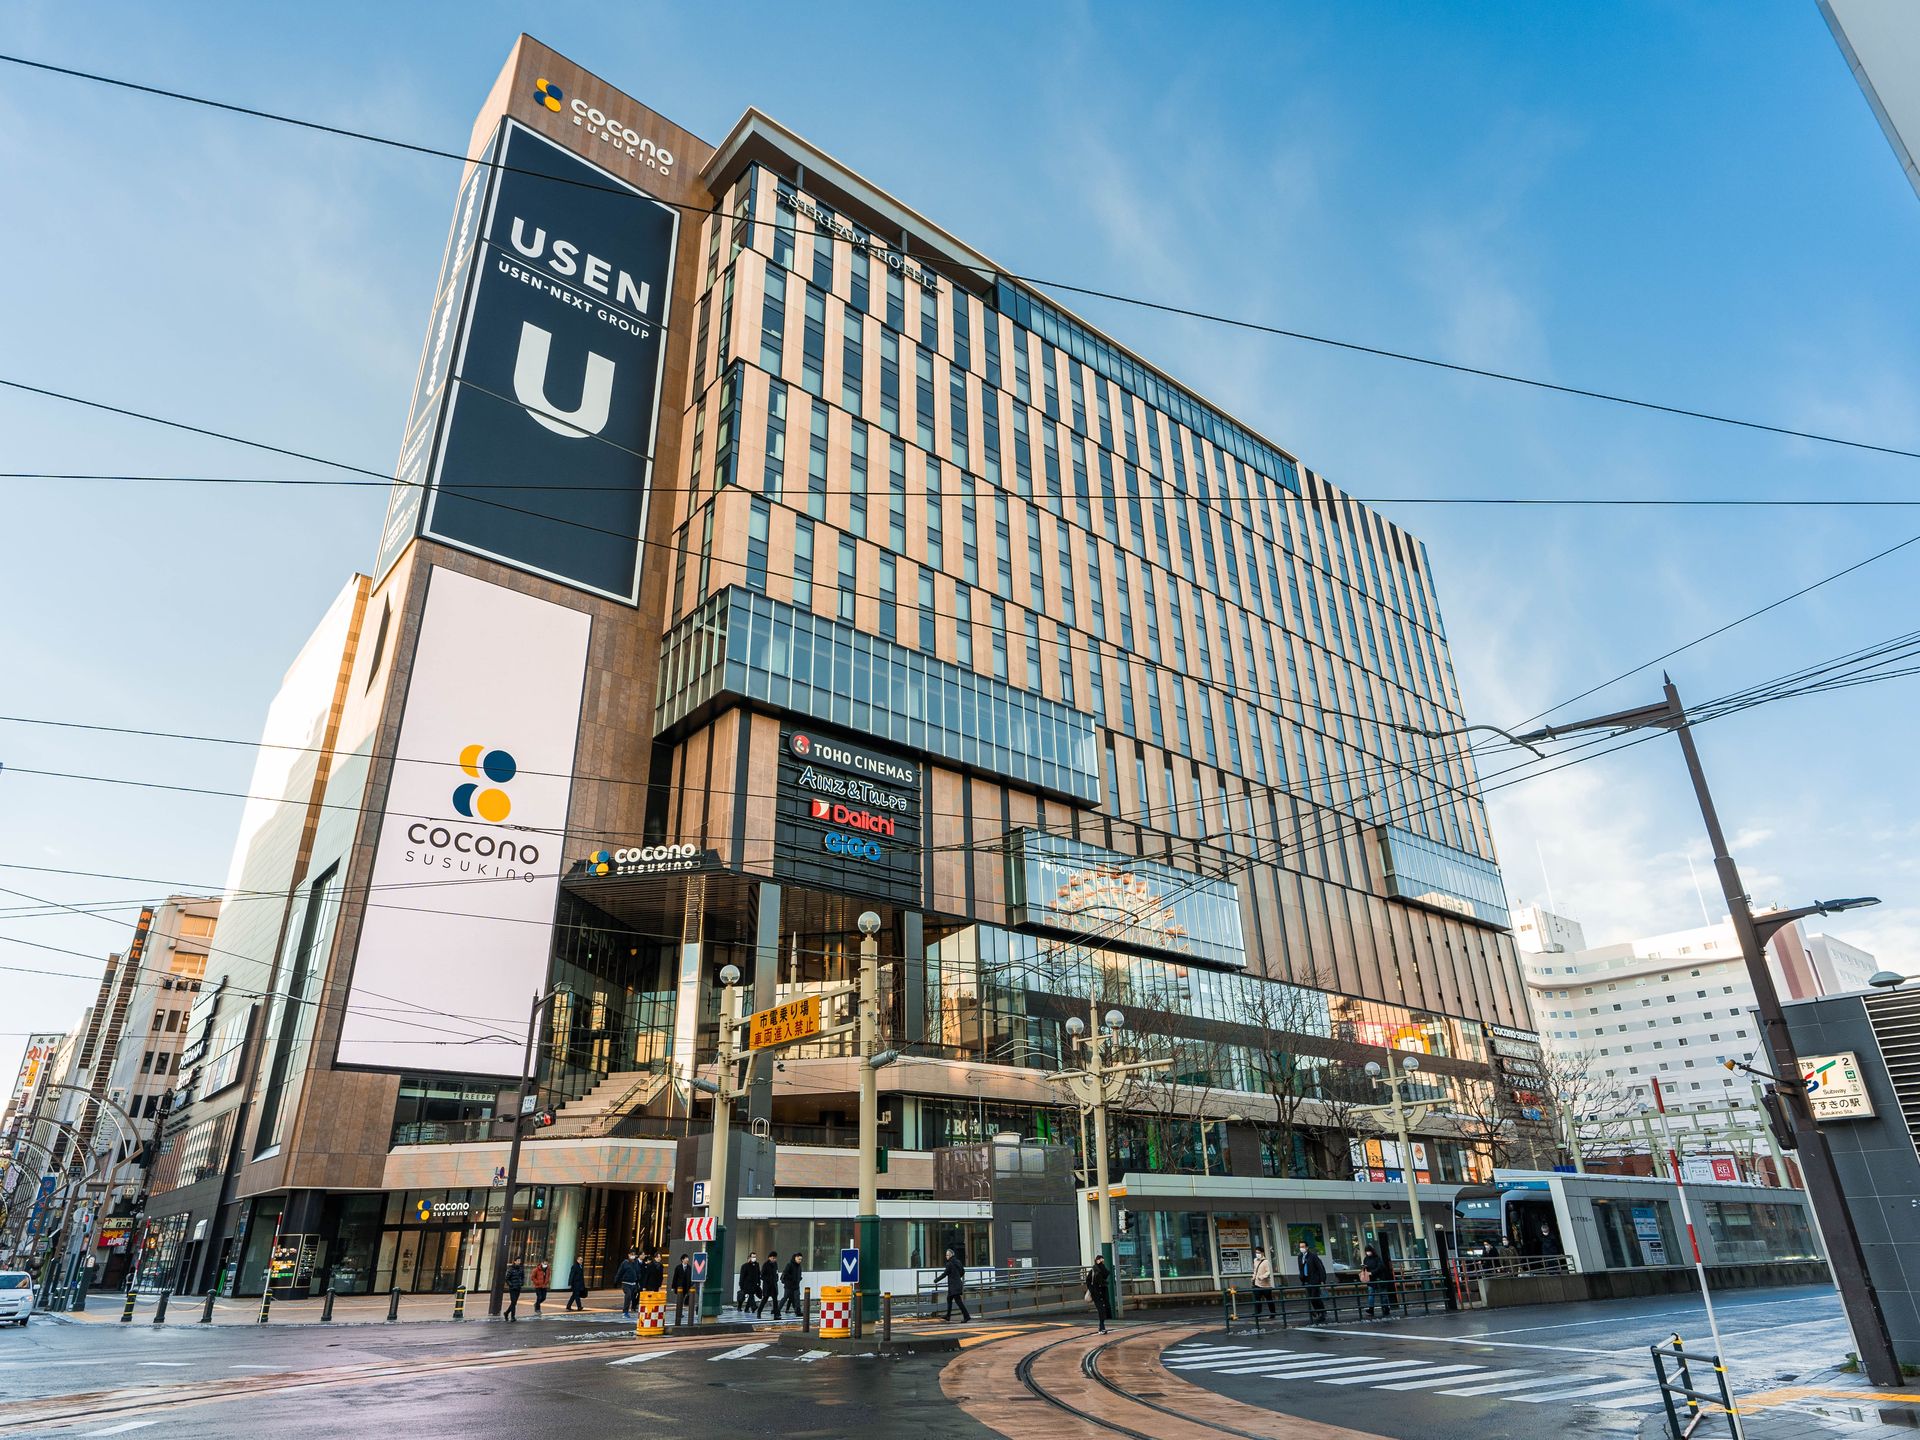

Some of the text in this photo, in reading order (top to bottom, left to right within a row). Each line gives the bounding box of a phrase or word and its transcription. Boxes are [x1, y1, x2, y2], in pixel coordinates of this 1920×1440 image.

[788, 193, 935, 289] STREAM HOTEL
[510, 216, 650, 314] USEN
[499, 260, 650, 340] USEN-NEXT GROUP
[813, 743, 913, 783] TOHO CINEMAS
[833, 804, 895, 836] Daiichi
[759, 1000, 809, 1028] 市電乗り場
[754, 1017, 814, 1046] 車両進入禁止
[1841, 1057, 1851, 1066] 2
[1811, 1098, 1861, 1111] すすきの駅
